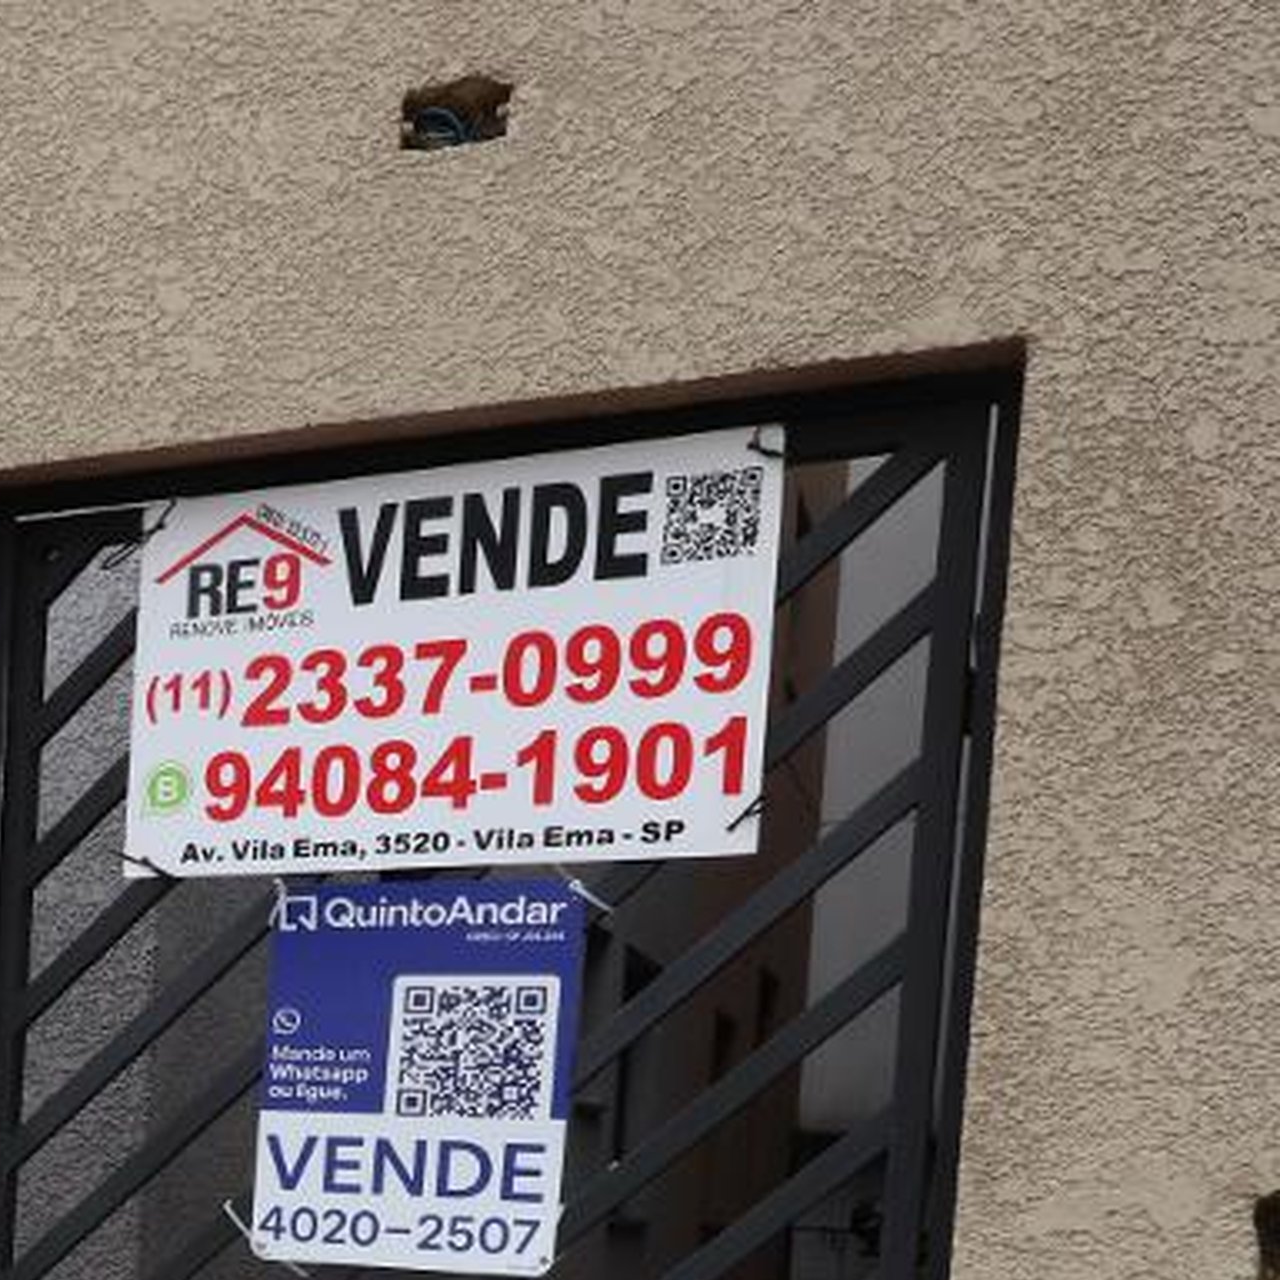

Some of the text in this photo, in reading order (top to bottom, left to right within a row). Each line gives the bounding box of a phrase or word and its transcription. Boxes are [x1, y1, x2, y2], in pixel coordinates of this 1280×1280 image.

[338, 471, 654, 606] VENDE
[187, 552, 301, 618] RE9
[145, 612, 754, 728] (11) 2337-0999
[204, 716, 749, 822] 94084-1901
[180, 841, 224, 864] Av.
[231, 837, 286, 862] Vila
[292, 837, 368, 860] Ema,
[374, 830, 449, 855] 3520
[473, 828, 535, 852] Vila
[543, 825, 614, 848] Ema
[640, 819, 685, 844] SP
[324, 893, 566, 931] QuintoAndar
[268, 1085, 294, 1098] ou
[269, 1063, 369, 1084] Whatsapp
[266, 1134, 546, 1204] VENDE
[258, 1205, 541, 1255] 4020-2507
